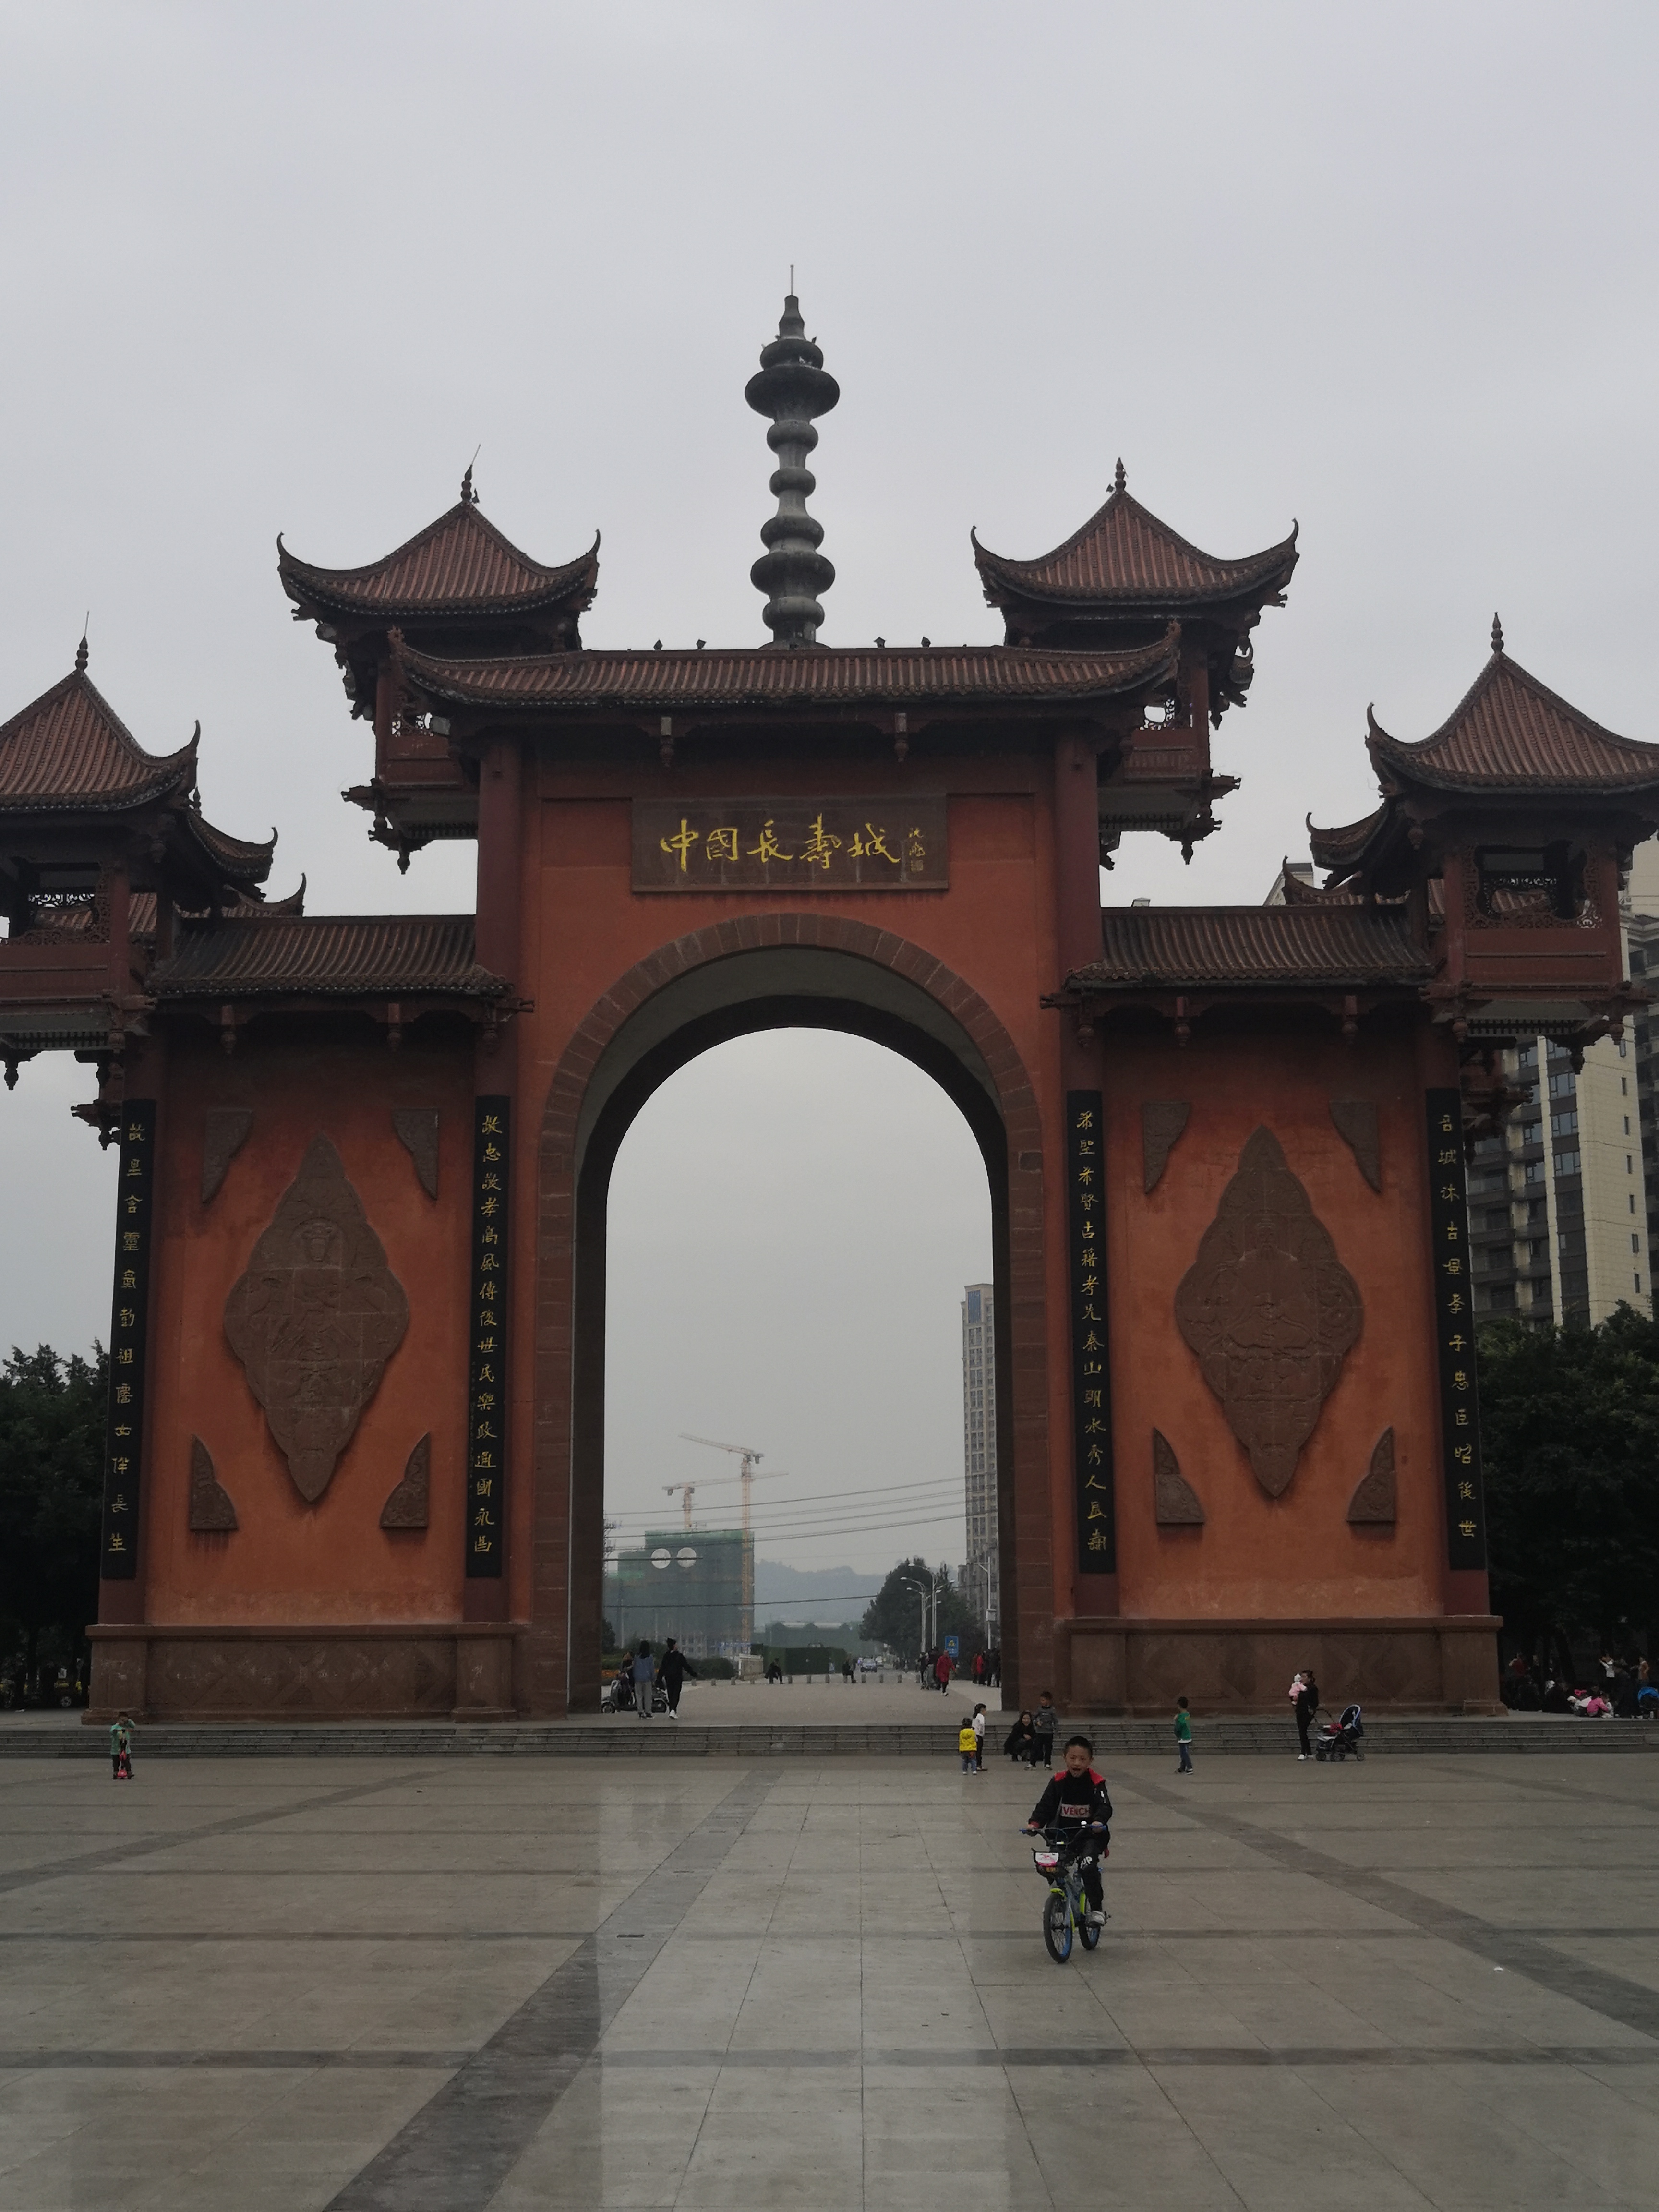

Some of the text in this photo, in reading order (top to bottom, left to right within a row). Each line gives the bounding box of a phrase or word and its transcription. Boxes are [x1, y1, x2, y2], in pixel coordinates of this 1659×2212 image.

[661, 813, 901, 872] 中國長壽城
